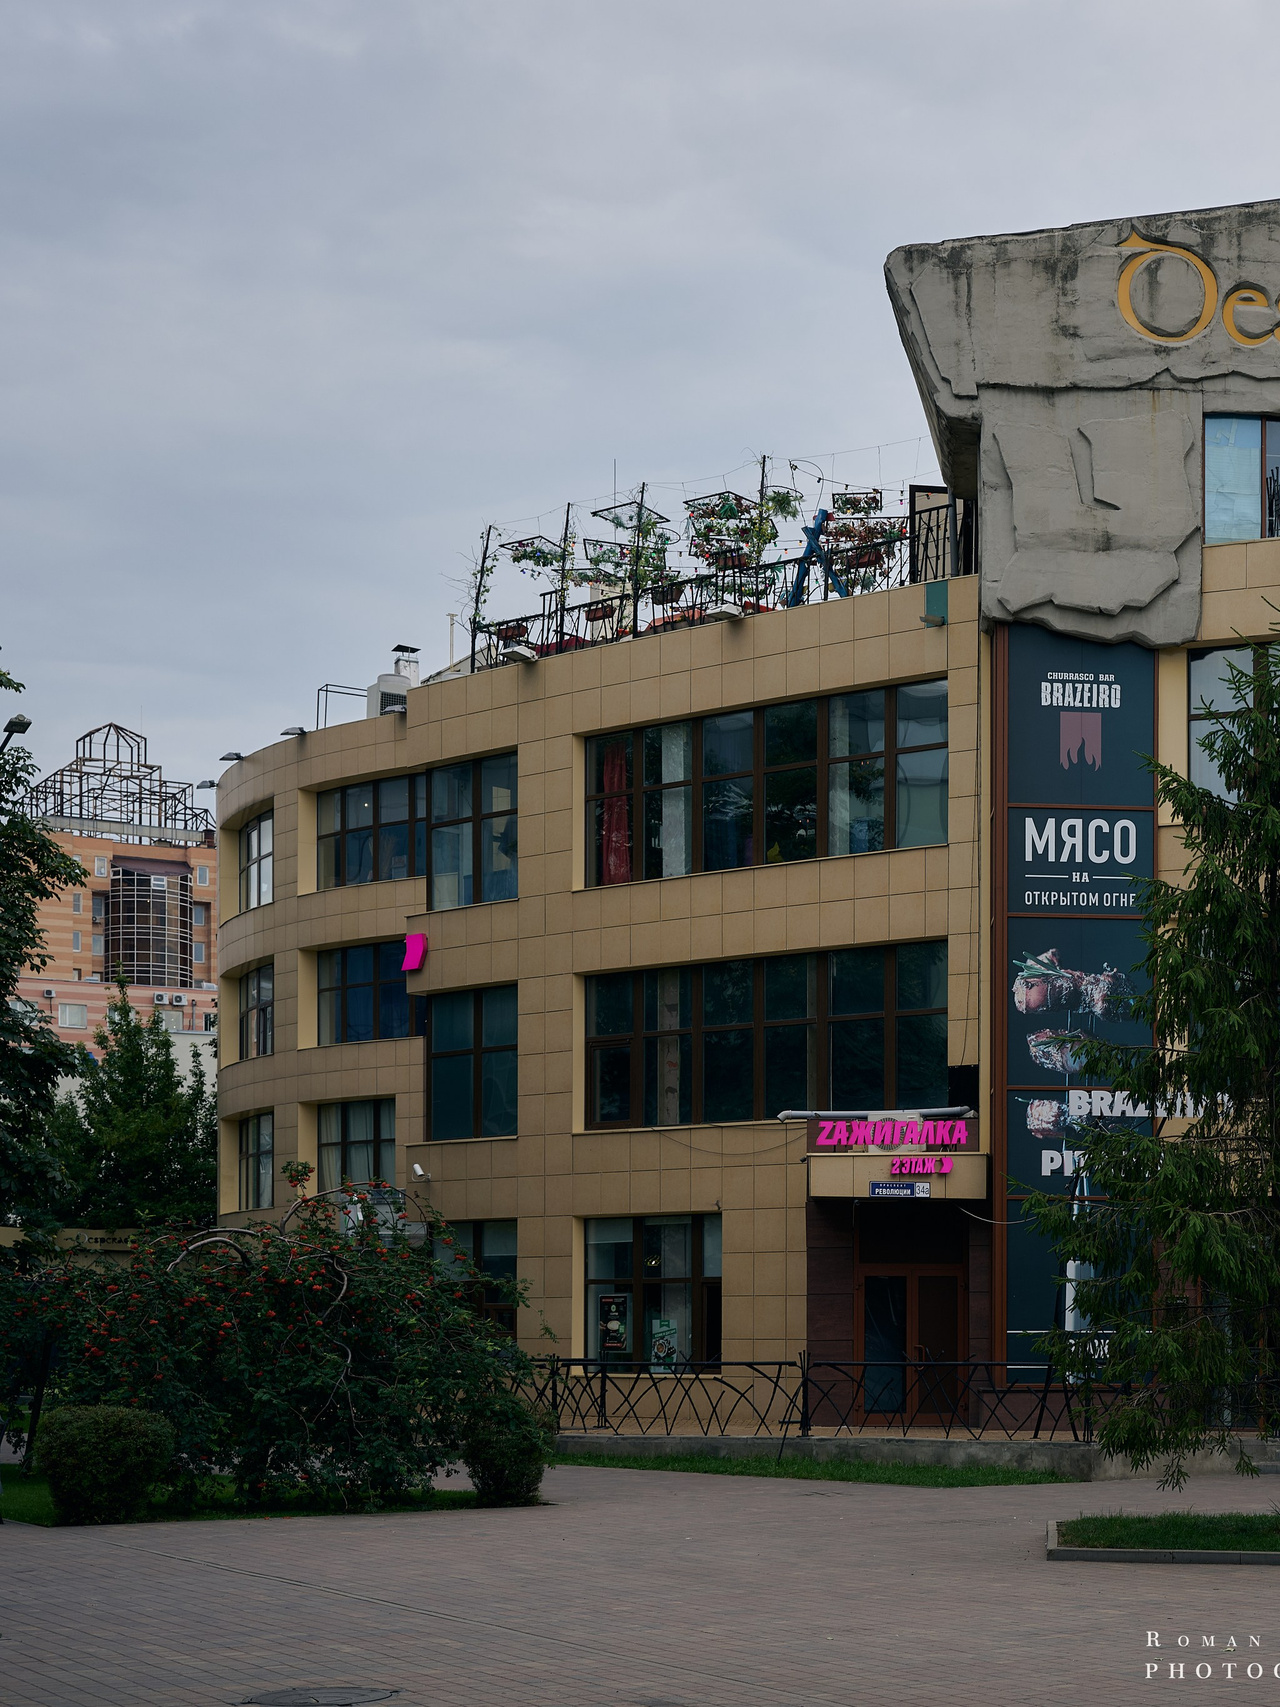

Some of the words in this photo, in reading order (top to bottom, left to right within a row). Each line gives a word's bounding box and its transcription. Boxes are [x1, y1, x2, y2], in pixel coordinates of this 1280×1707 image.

[1047, 671, 1094, 681] CHURRASCO
[1098, 673, 1115, 682] BAR
[1040, 681, 1121, 709] BRAZEIRO
[1024, 817, 1137, 865] МЯСО
[1072, 871, 1090, 883] НА
[1024, 890, 1099, 907] ОТКРЫТОМ
[890, 1156, 901, 1175] 2
[901, 1156, 937, 1175] ЭТАЖ
[874, 1188, 912, 1196] РЕВОЛЮЦИИ
